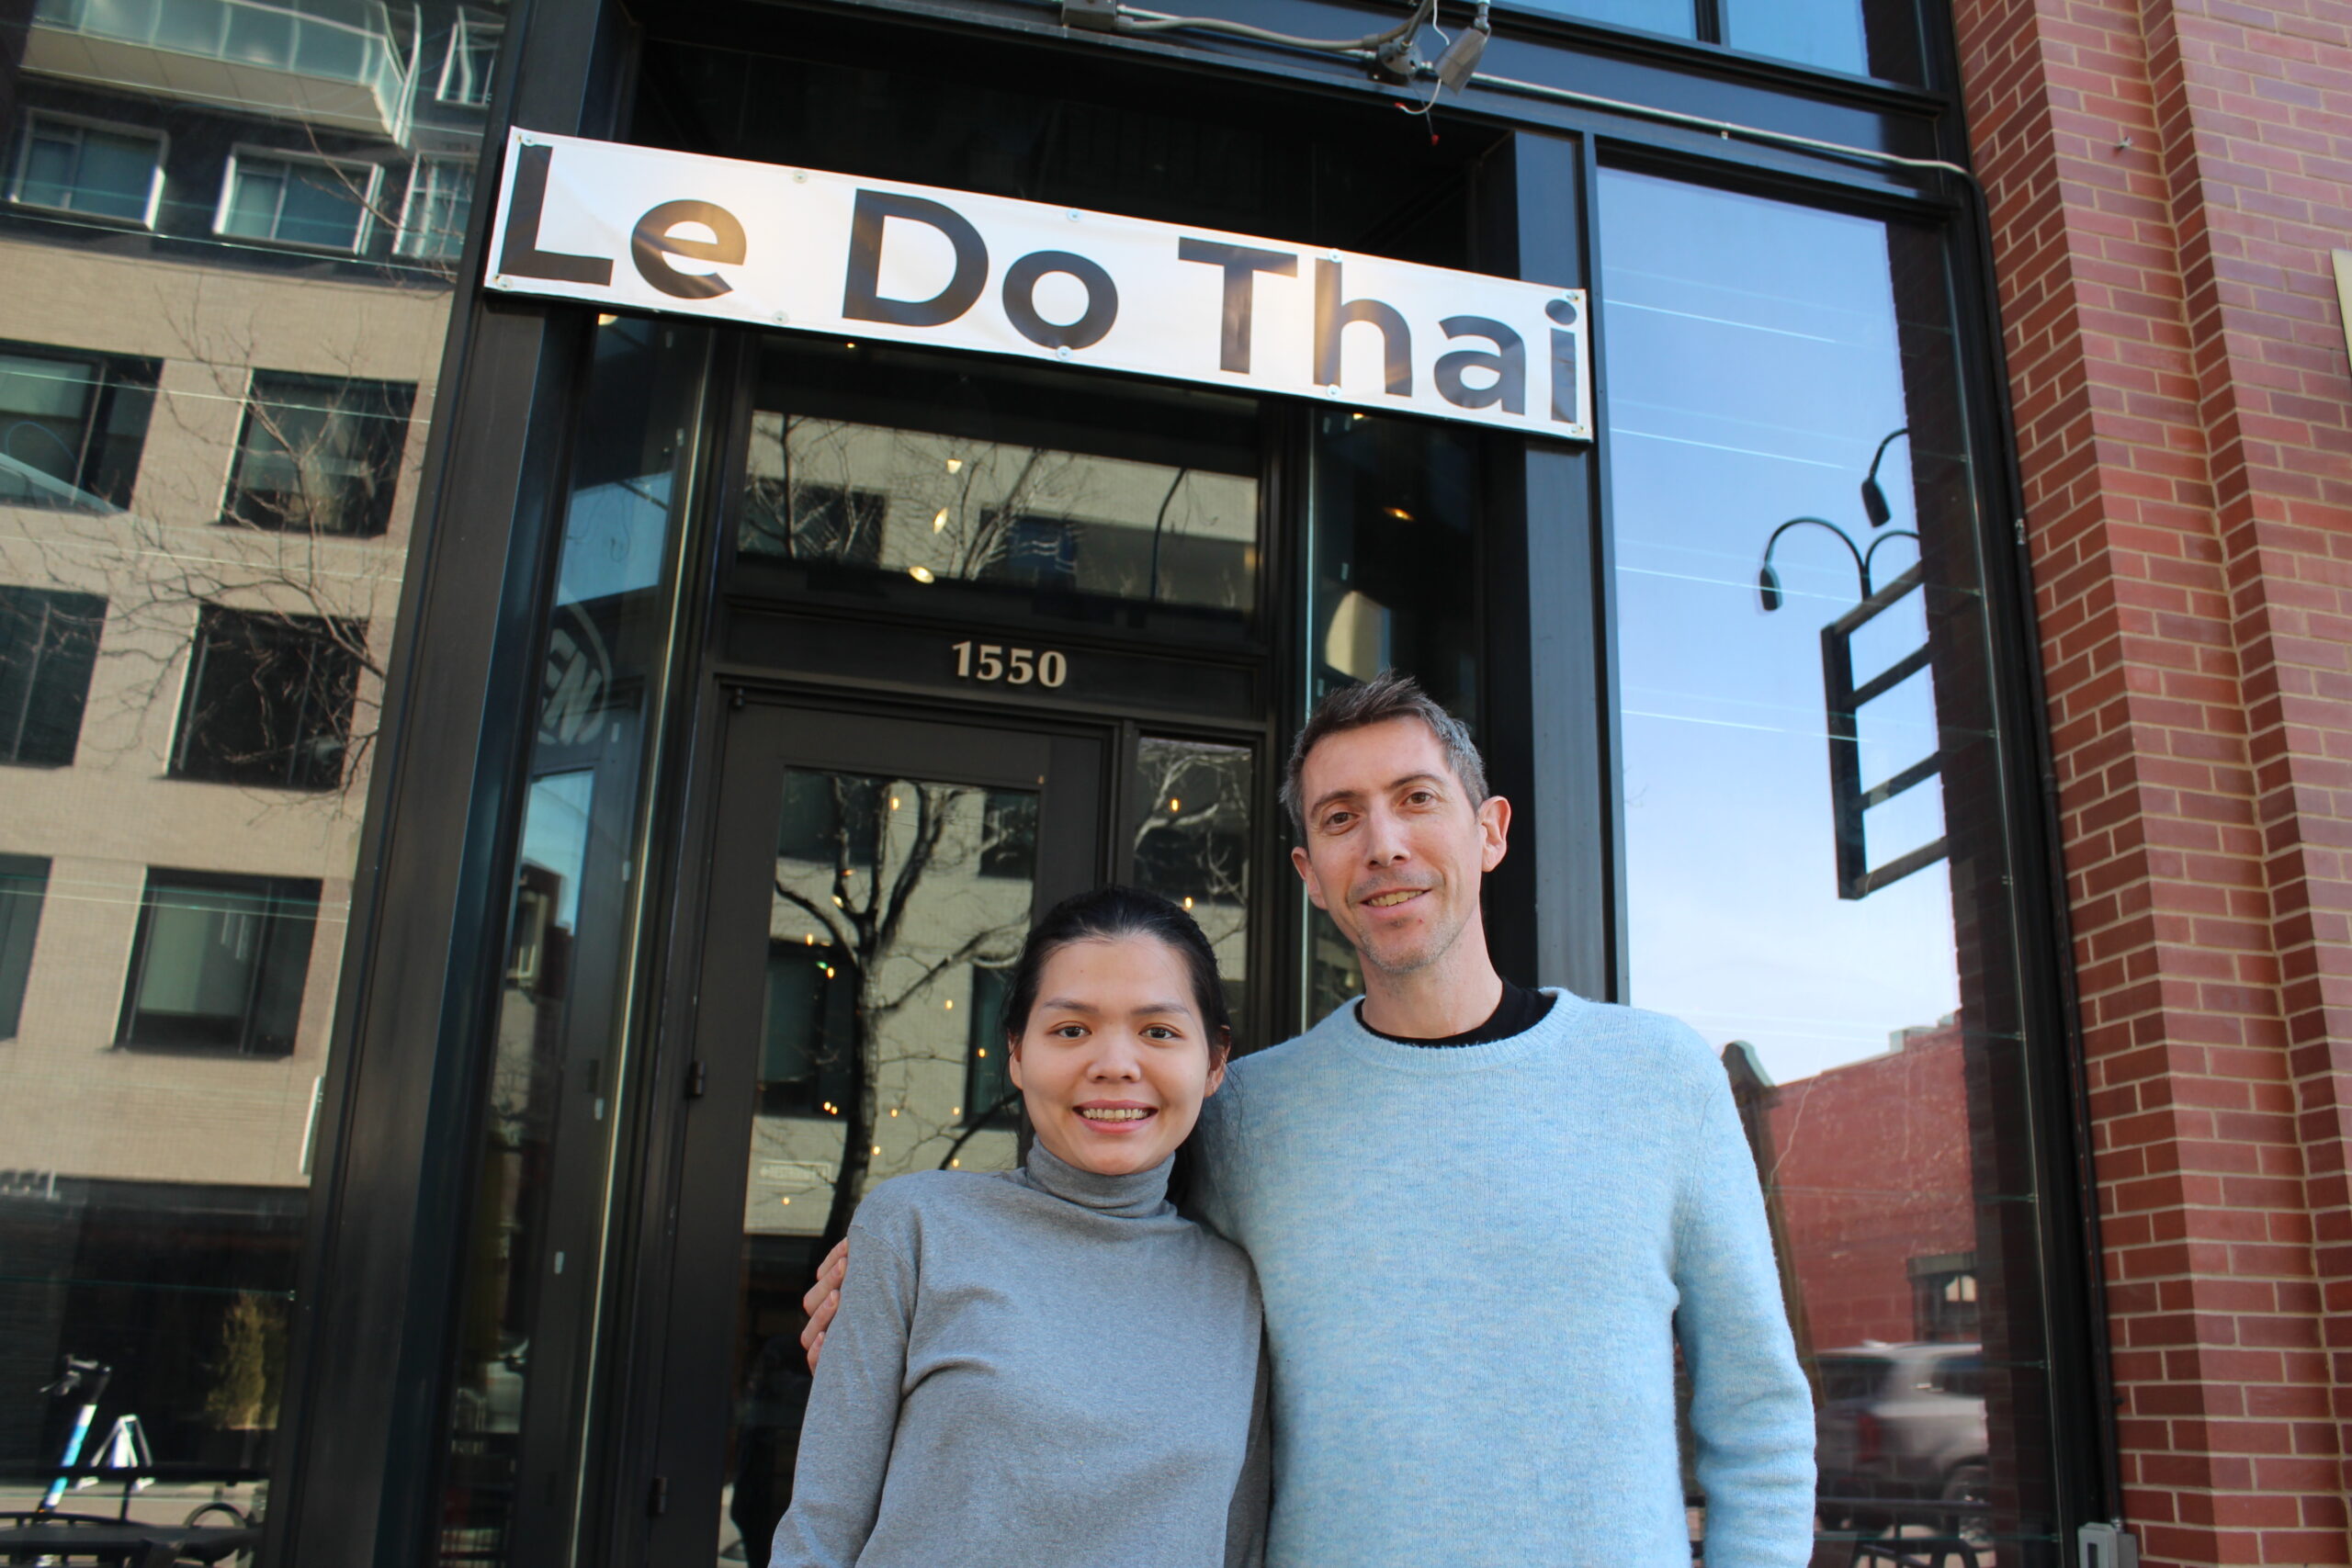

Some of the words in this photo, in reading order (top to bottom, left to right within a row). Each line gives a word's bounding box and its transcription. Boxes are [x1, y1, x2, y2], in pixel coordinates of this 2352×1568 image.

[497, 142, 747, 299] Le
[842, 187, 1119, 351] Do
[1178, 236, 1578, 424] Thai
[952, 640, 1068, 687] 1550
